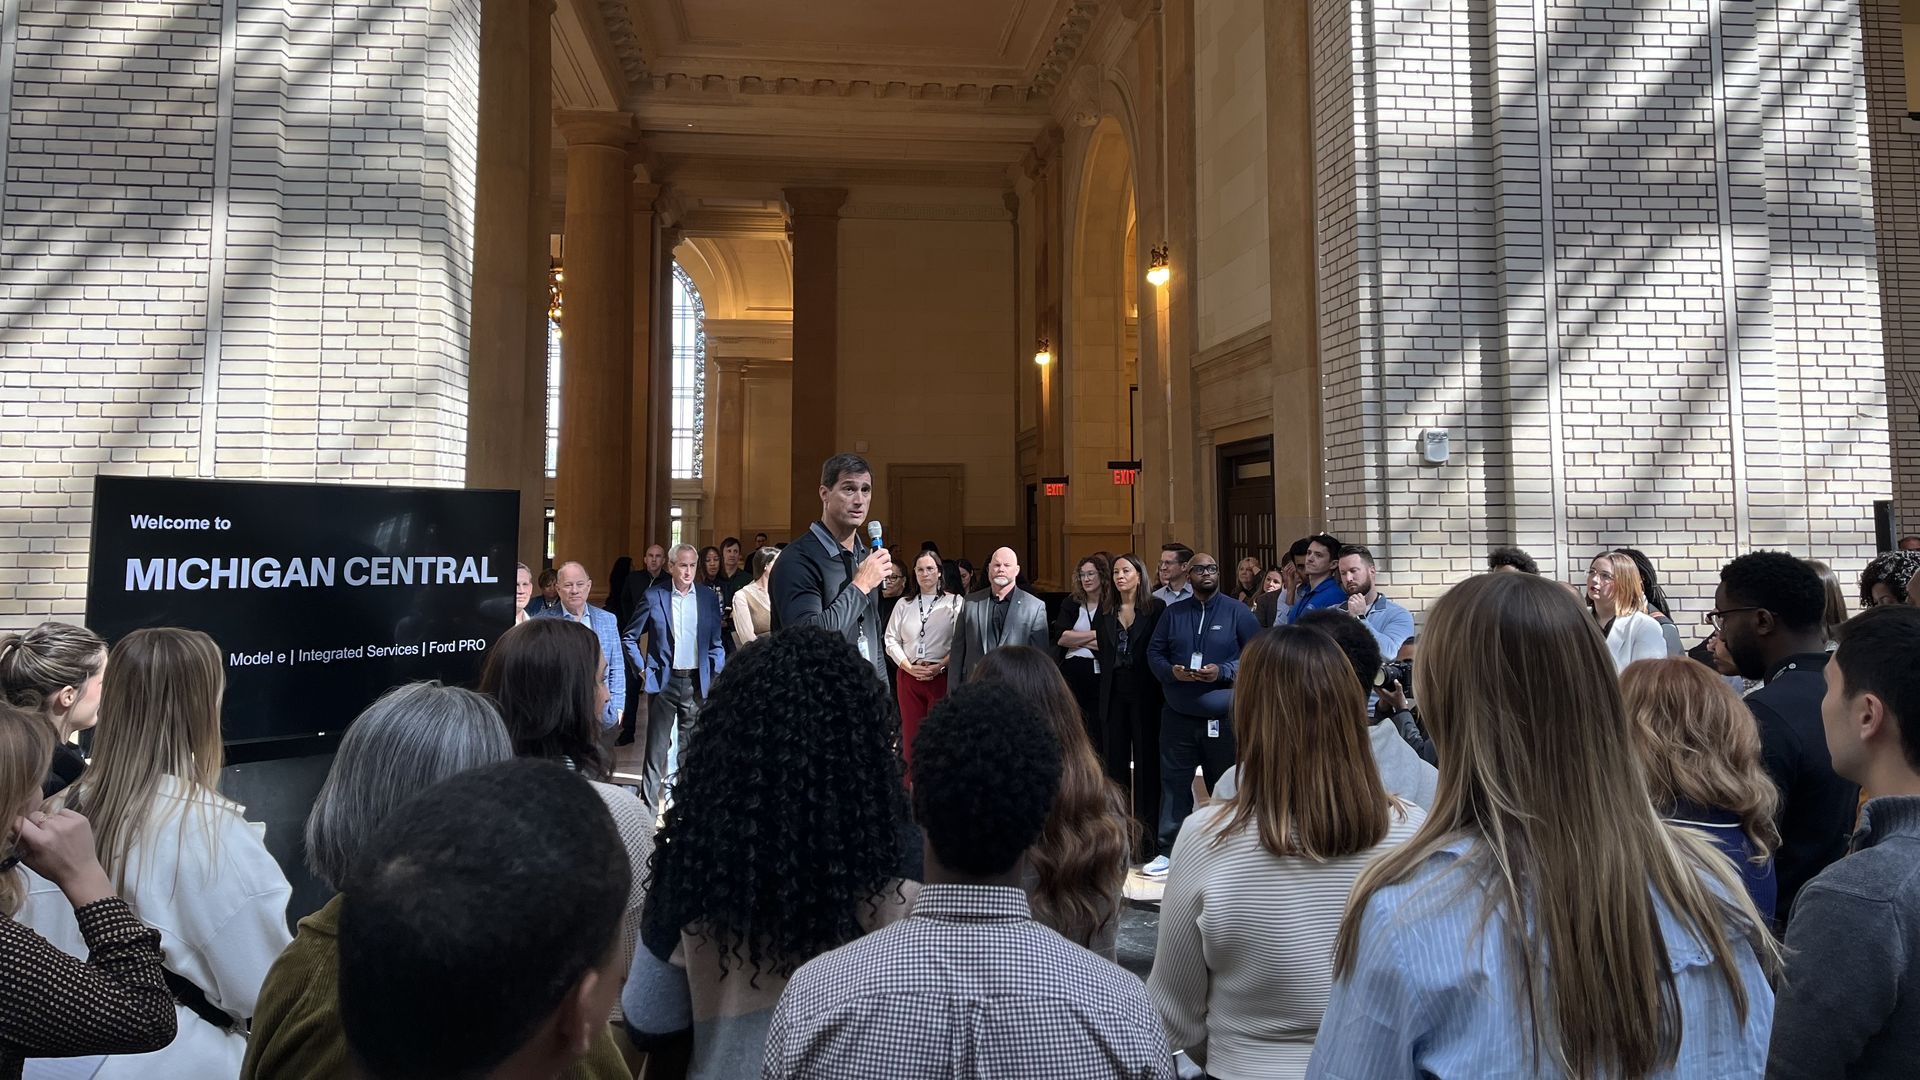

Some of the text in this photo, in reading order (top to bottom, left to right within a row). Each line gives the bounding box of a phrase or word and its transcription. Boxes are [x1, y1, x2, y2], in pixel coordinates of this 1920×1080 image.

[1113, 470, 1135, 485] EXIT
[1046, 484, 1064, 496] EXIT
[130, 514, 232, 531] Welcome to
[124, 556, 499, 592] MICHIGAN CENTRAL
[229, 650, 274, 667] Model
[276, 653, 287, 664] e
[298, 645, 364, 664] Integrated
[366, 643, 419, 658] Services
[429, 640, 456, 654] Ford
[458, 638, 487, 652] PRO
